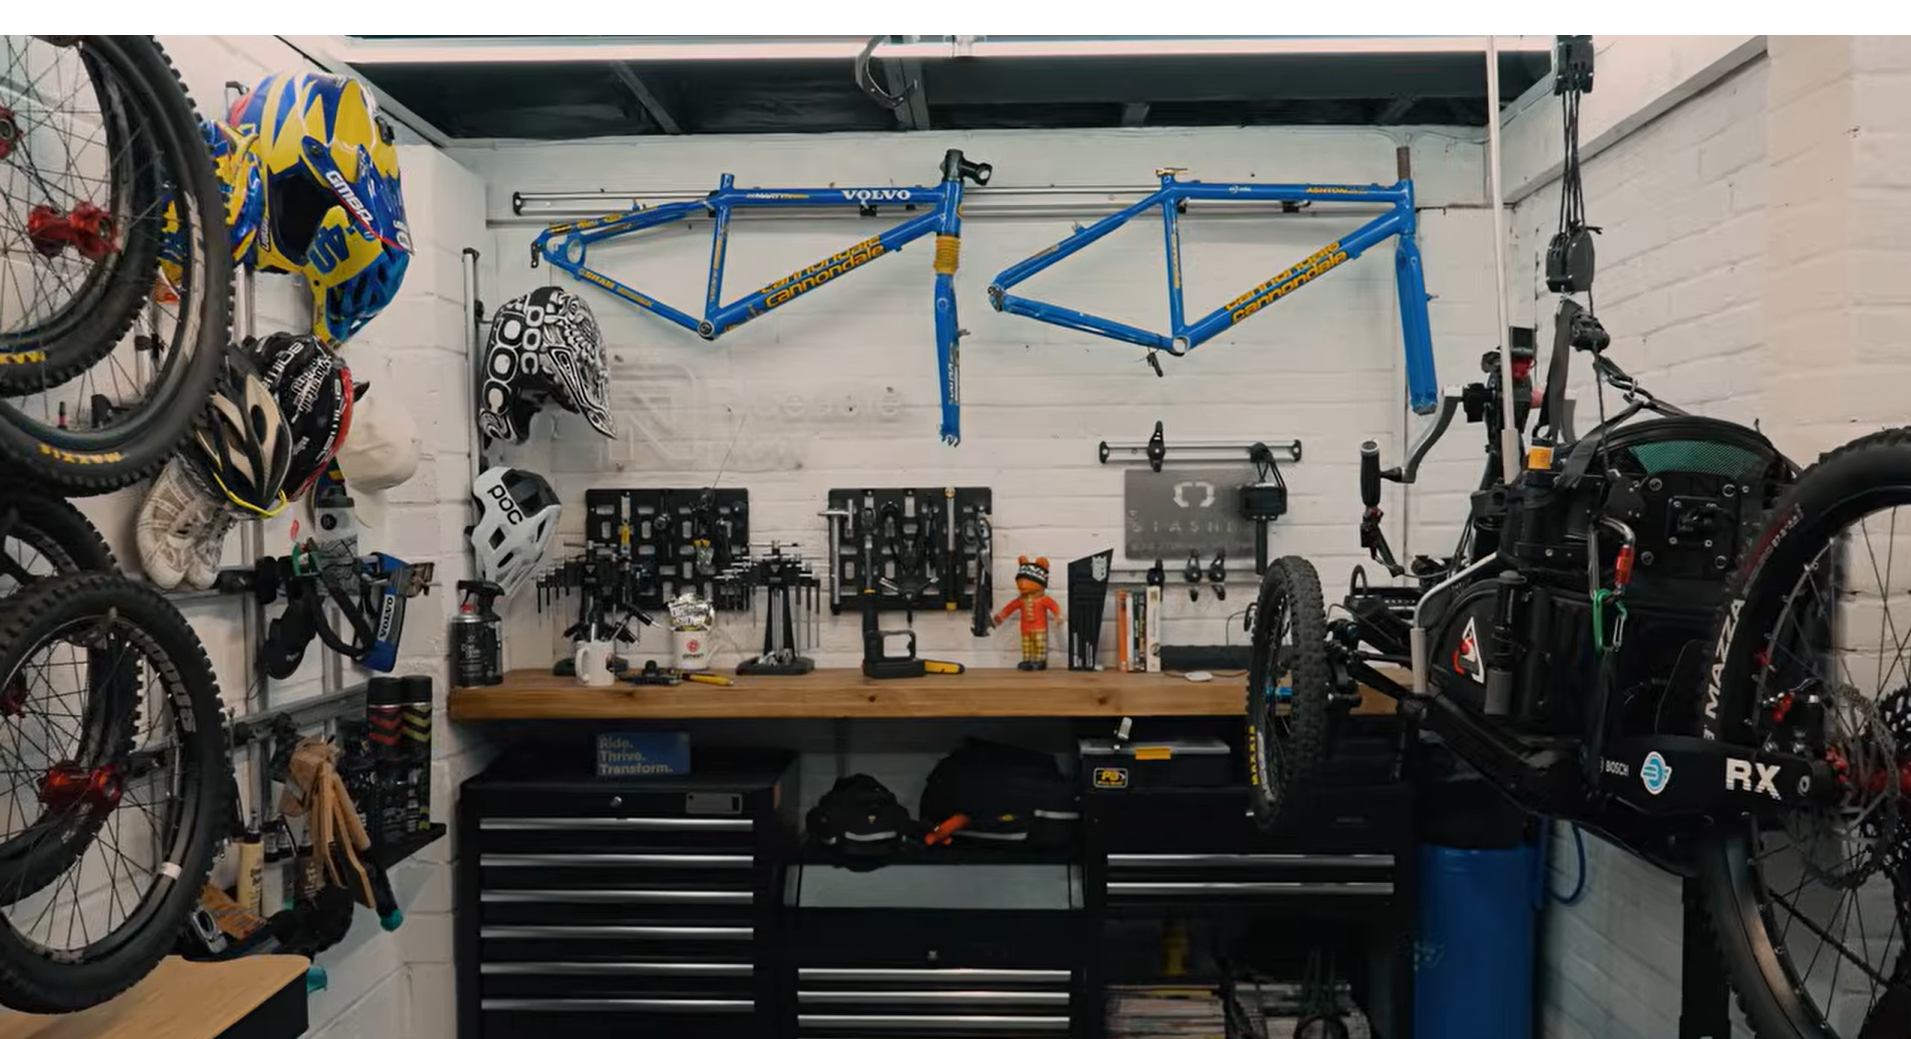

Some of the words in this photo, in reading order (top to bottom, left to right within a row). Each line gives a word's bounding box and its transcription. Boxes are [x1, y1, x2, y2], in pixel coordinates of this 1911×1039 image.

[841, 189, 911, 200] VOLVO
[765, 245, 885, 307] cannondale
[1232, 251, 1347, 324] cannondale
[379, 596, 394, 639] VOLVO
[1704, 600, 1746, 720] MAZZA
[600, 734, 634, 749] Ride.
[600, 748, 647, 763] Thrive.
[600, 762, 674, 776] Transform.
[1605, 760, 1630, 776] BOSCH
[1725, 757, 1782, 801] RX
